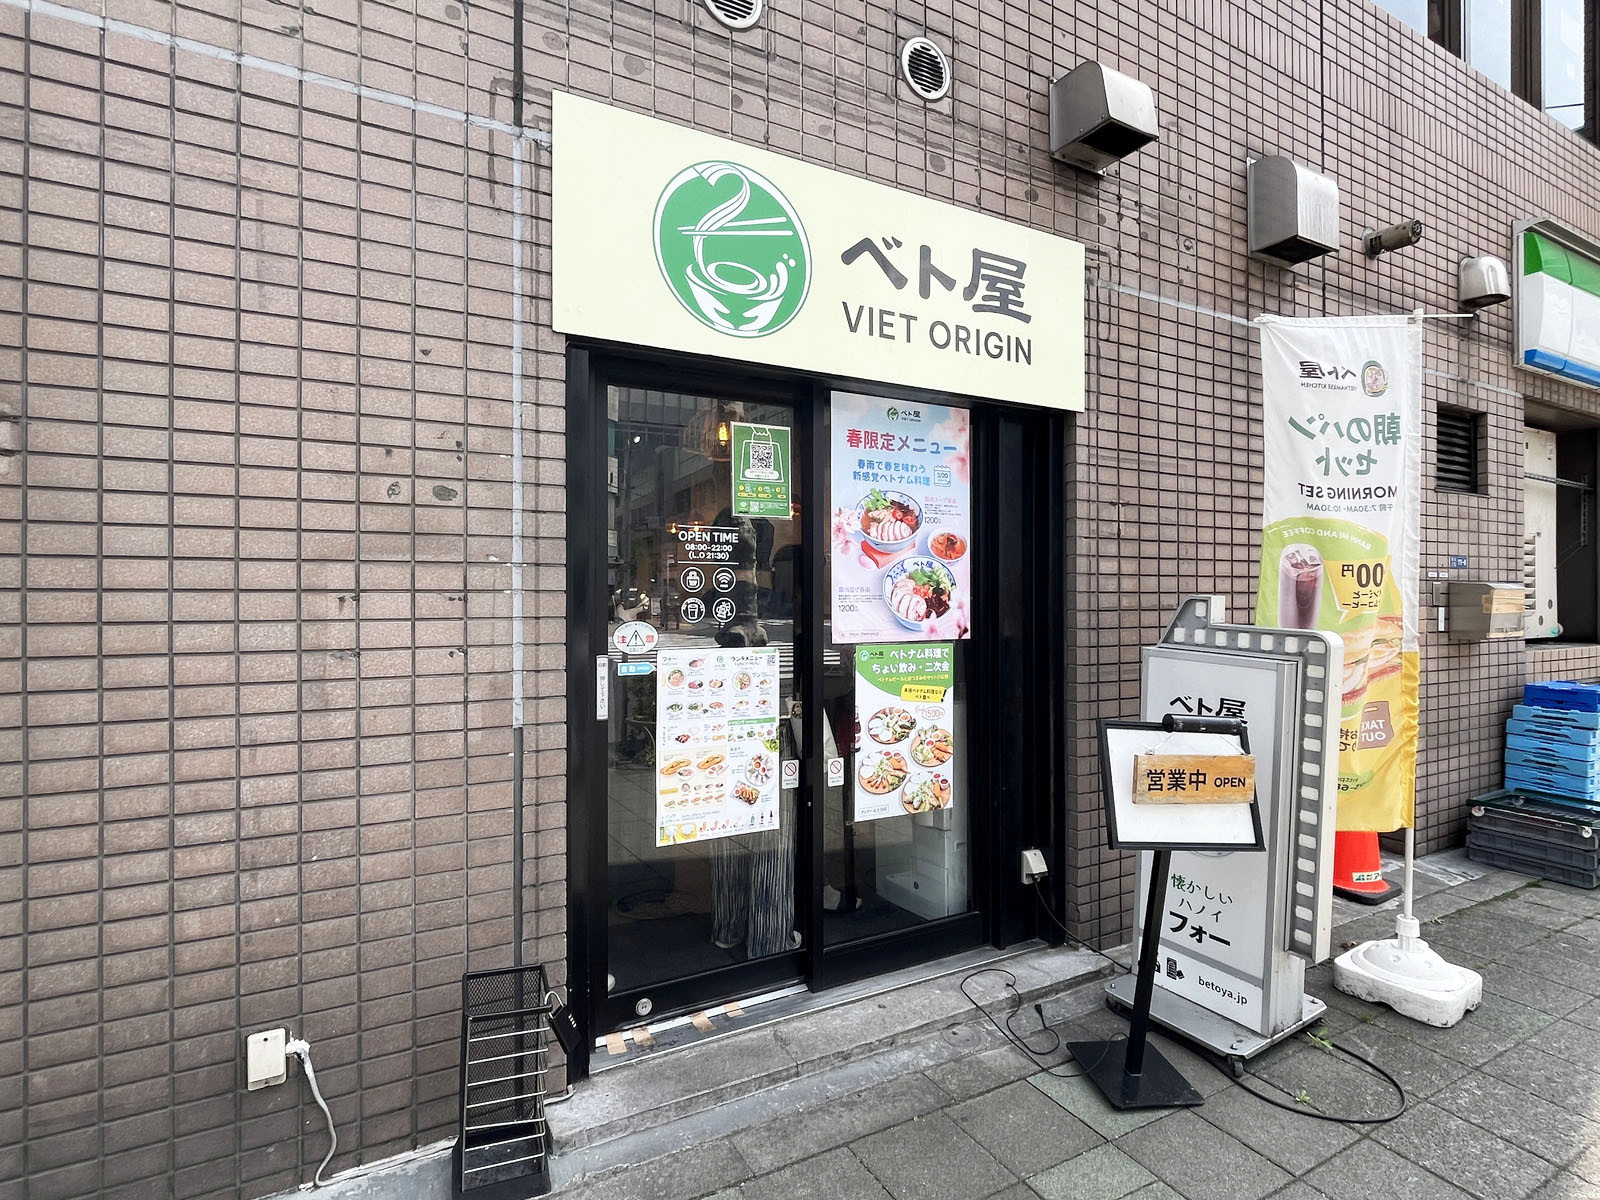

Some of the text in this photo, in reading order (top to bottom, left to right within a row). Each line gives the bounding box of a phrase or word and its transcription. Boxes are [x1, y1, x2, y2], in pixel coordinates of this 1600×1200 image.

[841, 235, 1032, 323] ベト屋
[841, 301, 1033, 366] VIET ORIGIN
[901, 410, 921, 418] ベト屋
[846, 428, 957, 455] 春限定メニュー
[857, 459, 926, 474] 春雨で春を味わう
[852, 471, 931, 487] 新感覚ベトナム料理
[678, 530, 739, 543] OPEN TIME
[685, 543, 733, 552] 08:00-22:00
[912, 560, 934, 569] ベト屋
[889, 648, 950, 659] ベトナム料理で
[872, 661, 950, 675] ちょい飲み・二次会
[1169, 695, 1248, 724] ベト屋
[1146, 768, 1246, 792] 営業中 OPEN
[1170, 873, 1233, 905] 懐かしい
[1178, 897, 1222, 923] ハノイ
[1169, 910, 1231, 947] フォー
[1198, 975, 1248, 1006] betoya.jp
